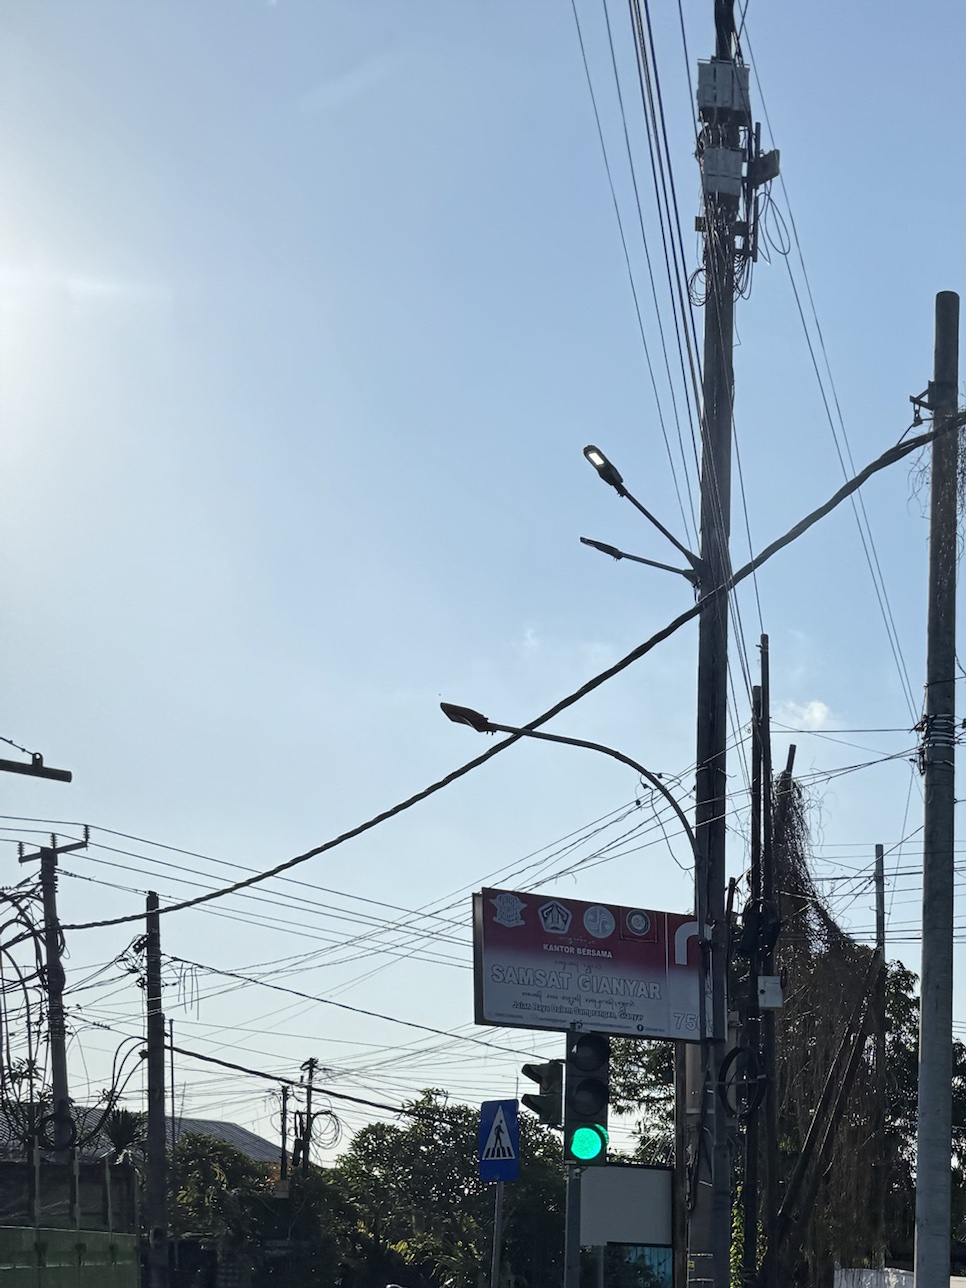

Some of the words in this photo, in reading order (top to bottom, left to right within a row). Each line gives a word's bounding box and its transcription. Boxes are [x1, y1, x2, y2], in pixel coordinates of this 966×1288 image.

[543, 943, 575, 954] KANTOR
[576, 947, 613, 959] BERSAMA
[490, 964, 572, 991] SAMSAT
[577, 973, 662, 1000] GIANYAR
[512, 1001, 531, 1011] Jalan
[532, 1002, 551, 1013] Raya
[618, 1010, 644, 1022] Gianyar
